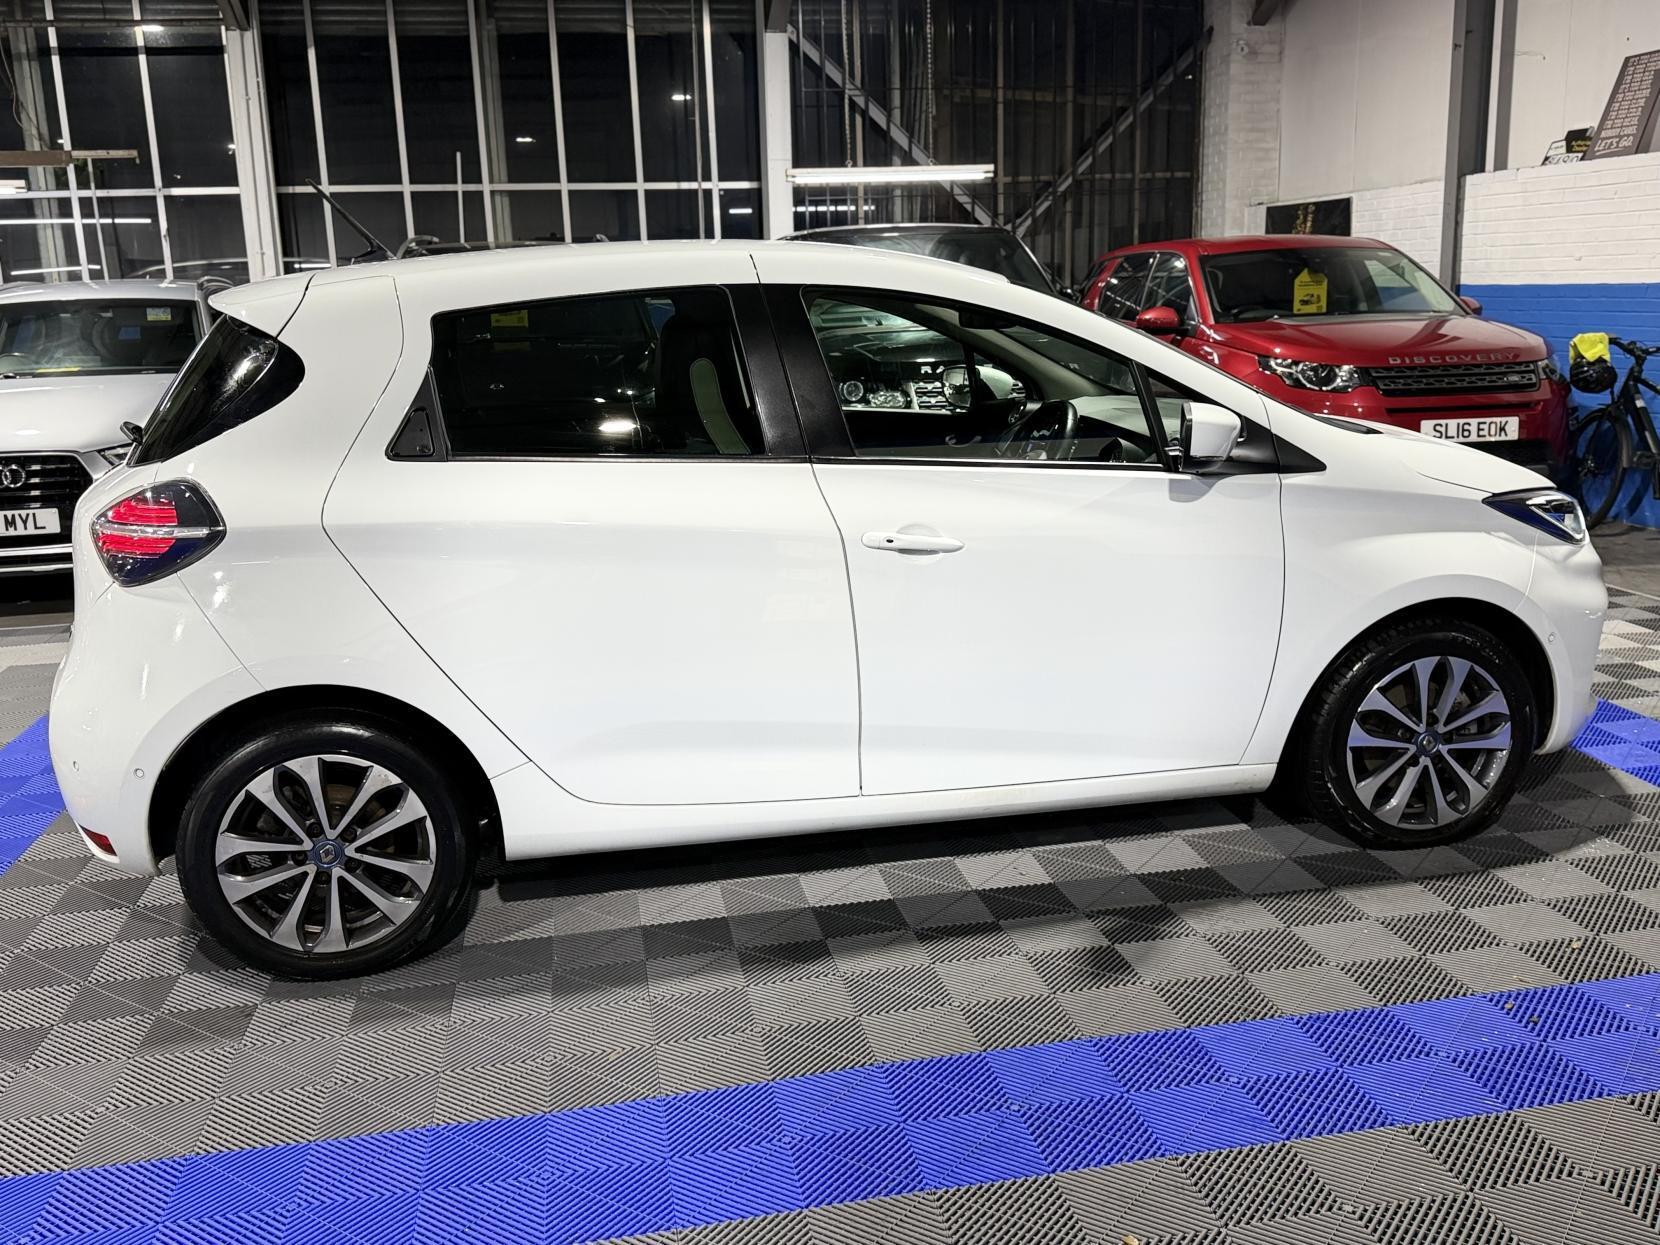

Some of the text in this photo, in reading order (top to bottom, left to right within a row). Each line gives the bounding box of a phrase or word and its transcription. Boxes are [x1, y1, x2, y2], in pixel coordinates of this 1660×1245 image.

[1594, 138, 1620, 151] LET'S
[1388, 352, 1515, 364] DISCOVERY
[1432, 420, 1509, 439] SL16 EOK
[3, 512, 47, 532] MYL
